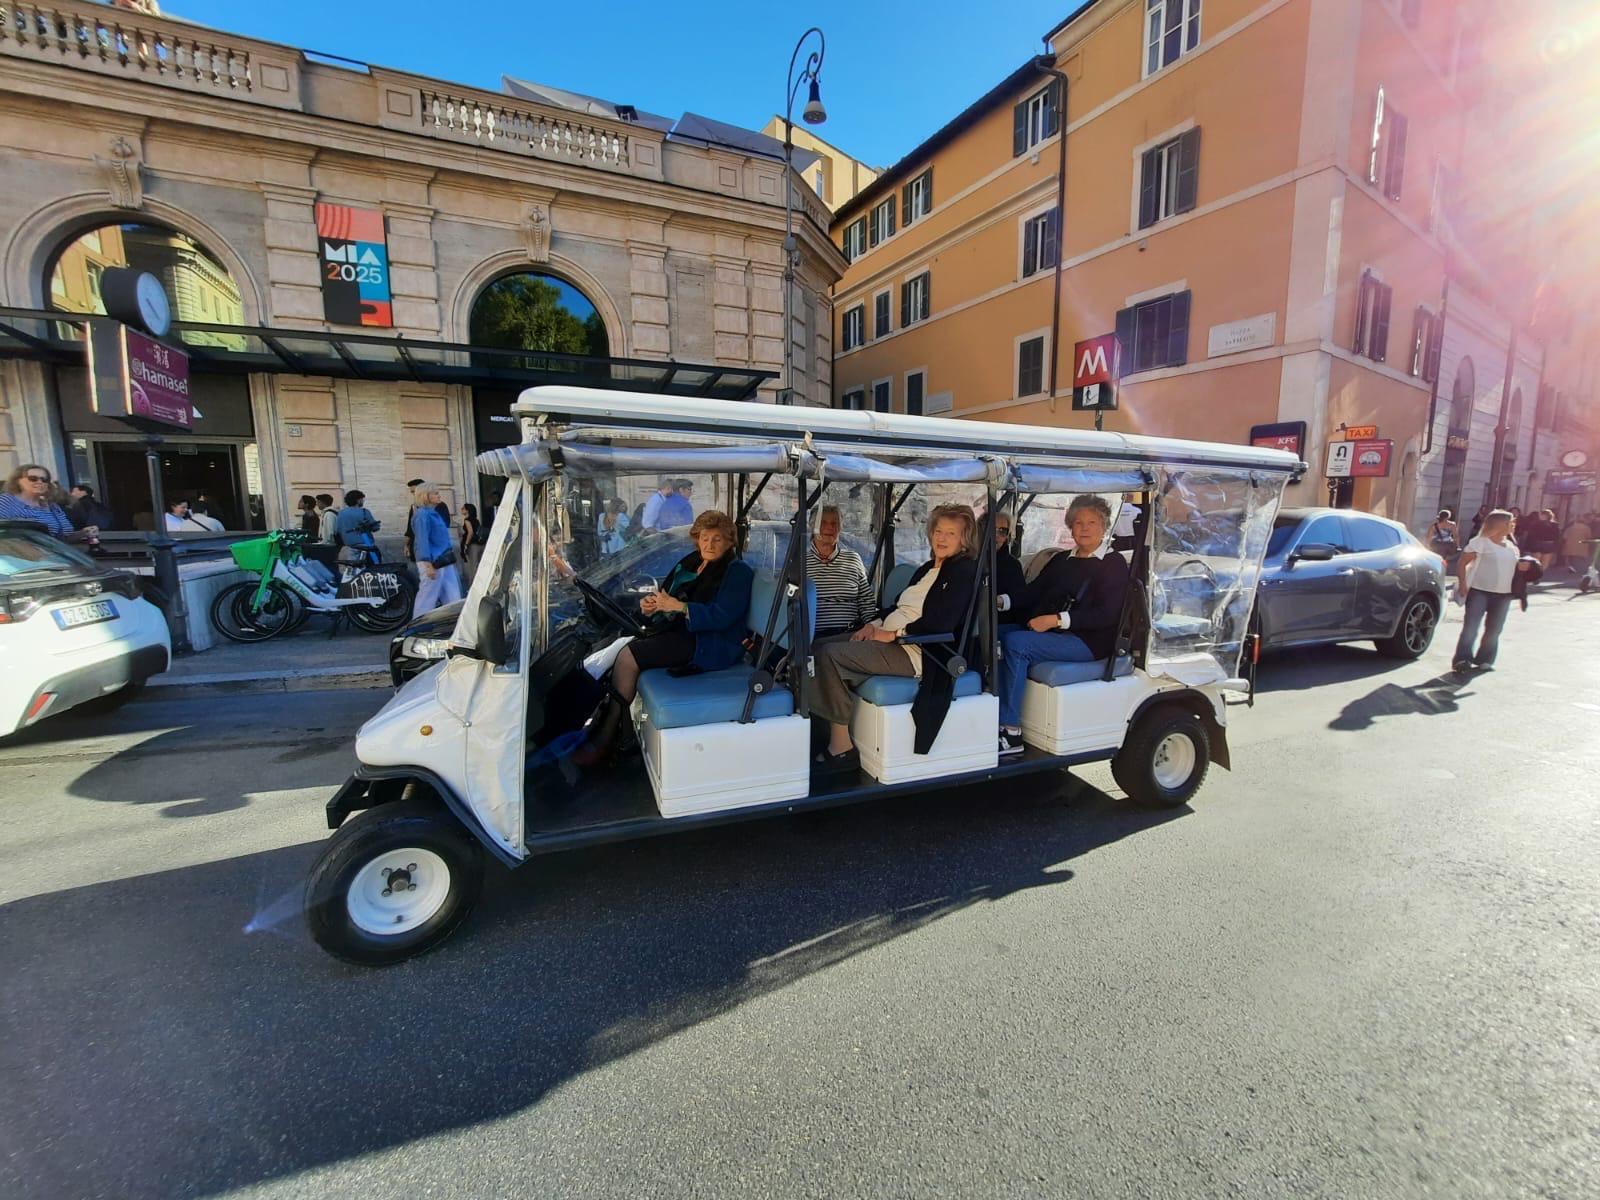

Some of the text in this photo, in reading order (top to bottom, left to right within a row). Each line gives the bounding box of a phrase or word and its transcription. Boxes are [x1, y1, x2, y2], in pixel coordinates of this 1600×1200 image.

[325, 242, 382, 266] MIA
[327, 262, 382, 284] 2025
[1077, 345, 1108, 378] M
[1277, 436, 1297, 445] KFC
[1349, 428, 1375, 438] TAXI
